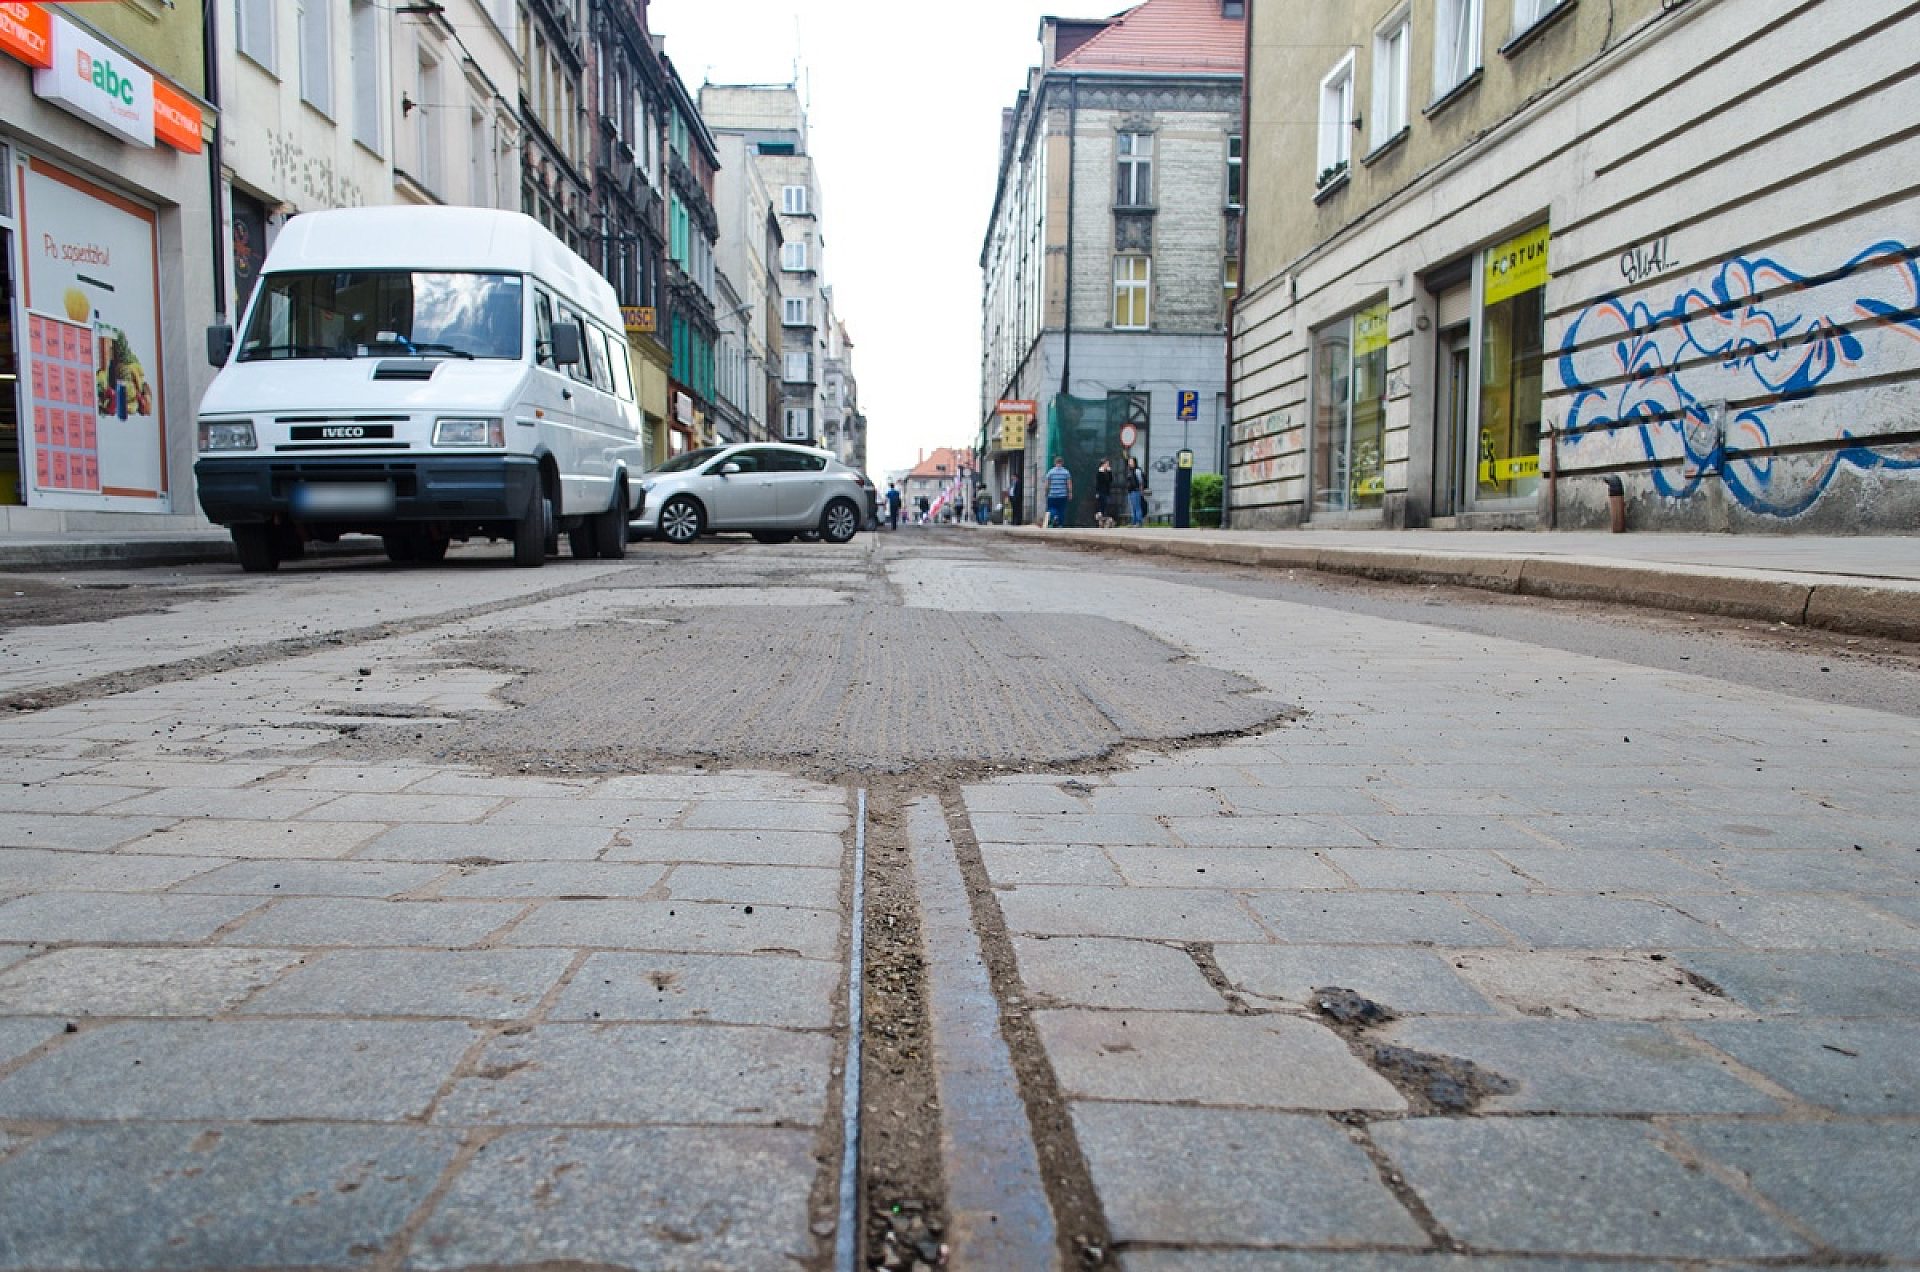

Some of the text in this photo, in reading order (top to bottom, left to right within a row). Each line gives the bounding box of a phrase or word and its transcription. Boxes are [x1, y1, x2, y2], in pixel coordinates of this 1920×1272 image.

[92, 59, 134, 106] abc
[1183, 391, 1195, 406] P
[322, 426, 364, 438] IVECO
